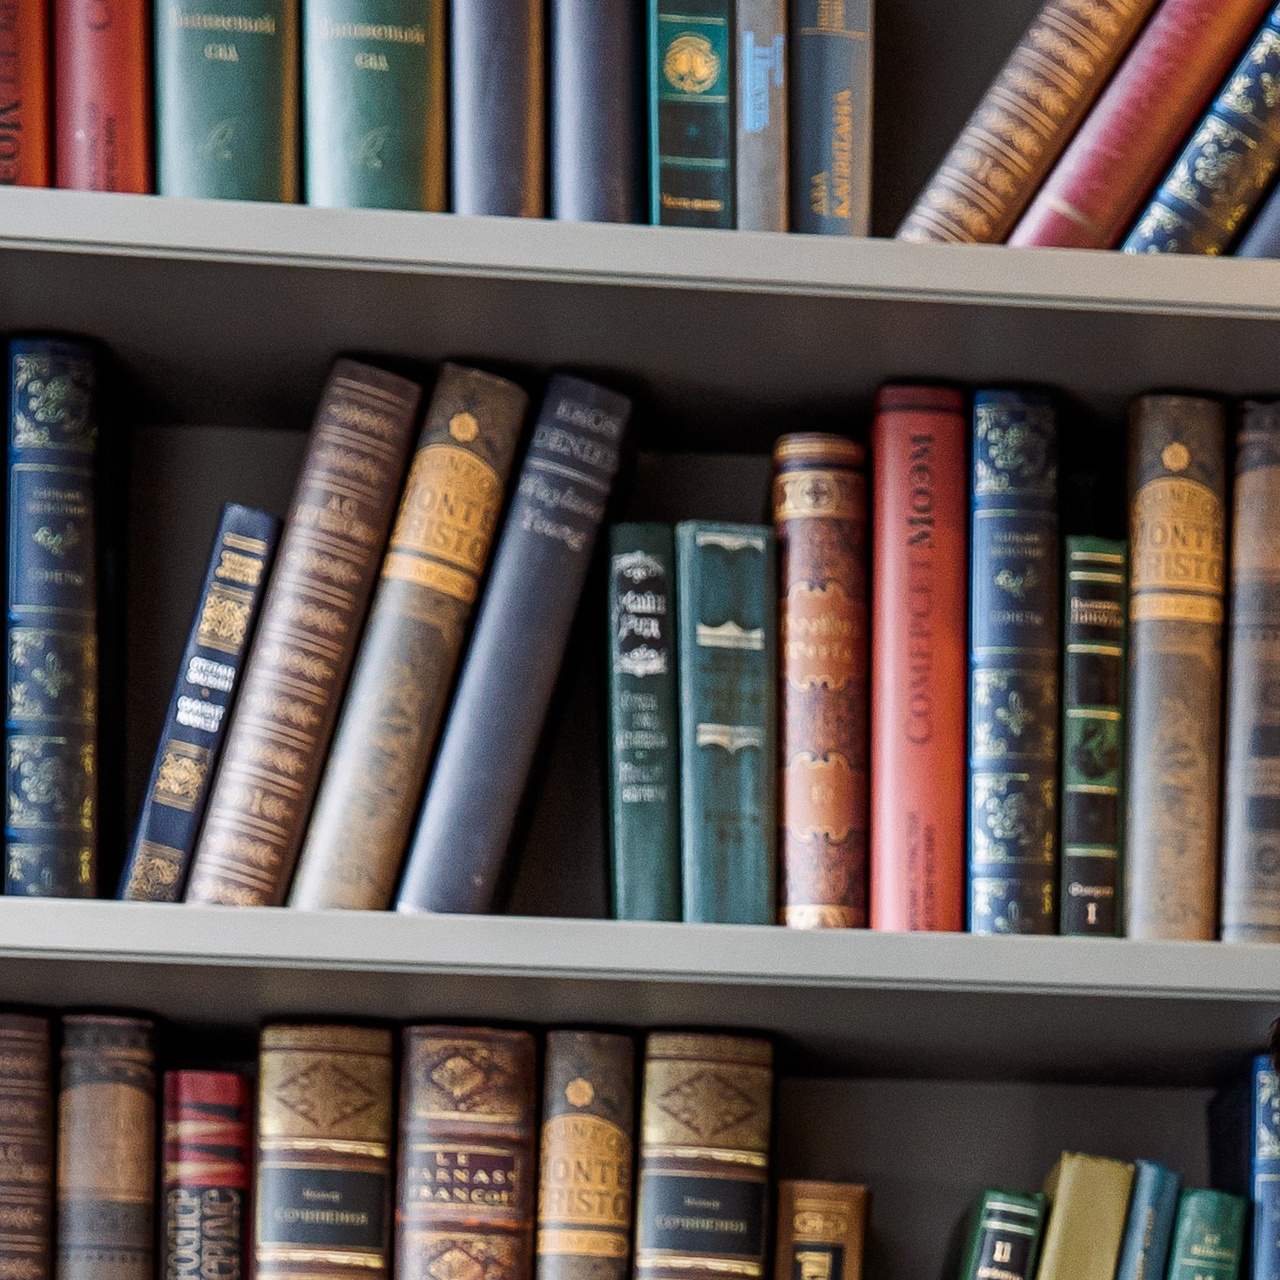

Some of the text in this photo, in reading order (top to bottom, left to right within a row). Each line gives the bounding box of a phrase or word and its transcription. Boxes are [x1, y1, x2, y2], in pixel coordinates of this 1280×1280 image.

[203, 43, 239, 62] сад
[354, 52, 389, 71] сад
[407, 517, 488, 561] RISTO
[1141, 552, 1223, 584] RISTO
[905, 432, 935, 745] СОМЕРСЕТ МОЭМ
[436, 1152, 469, 1166] LE
[273, 1206, 369, 1225] СОЧИНЕНИЯ
[655, 1214, 747, 1232] СОЧИНЕНИЯ
